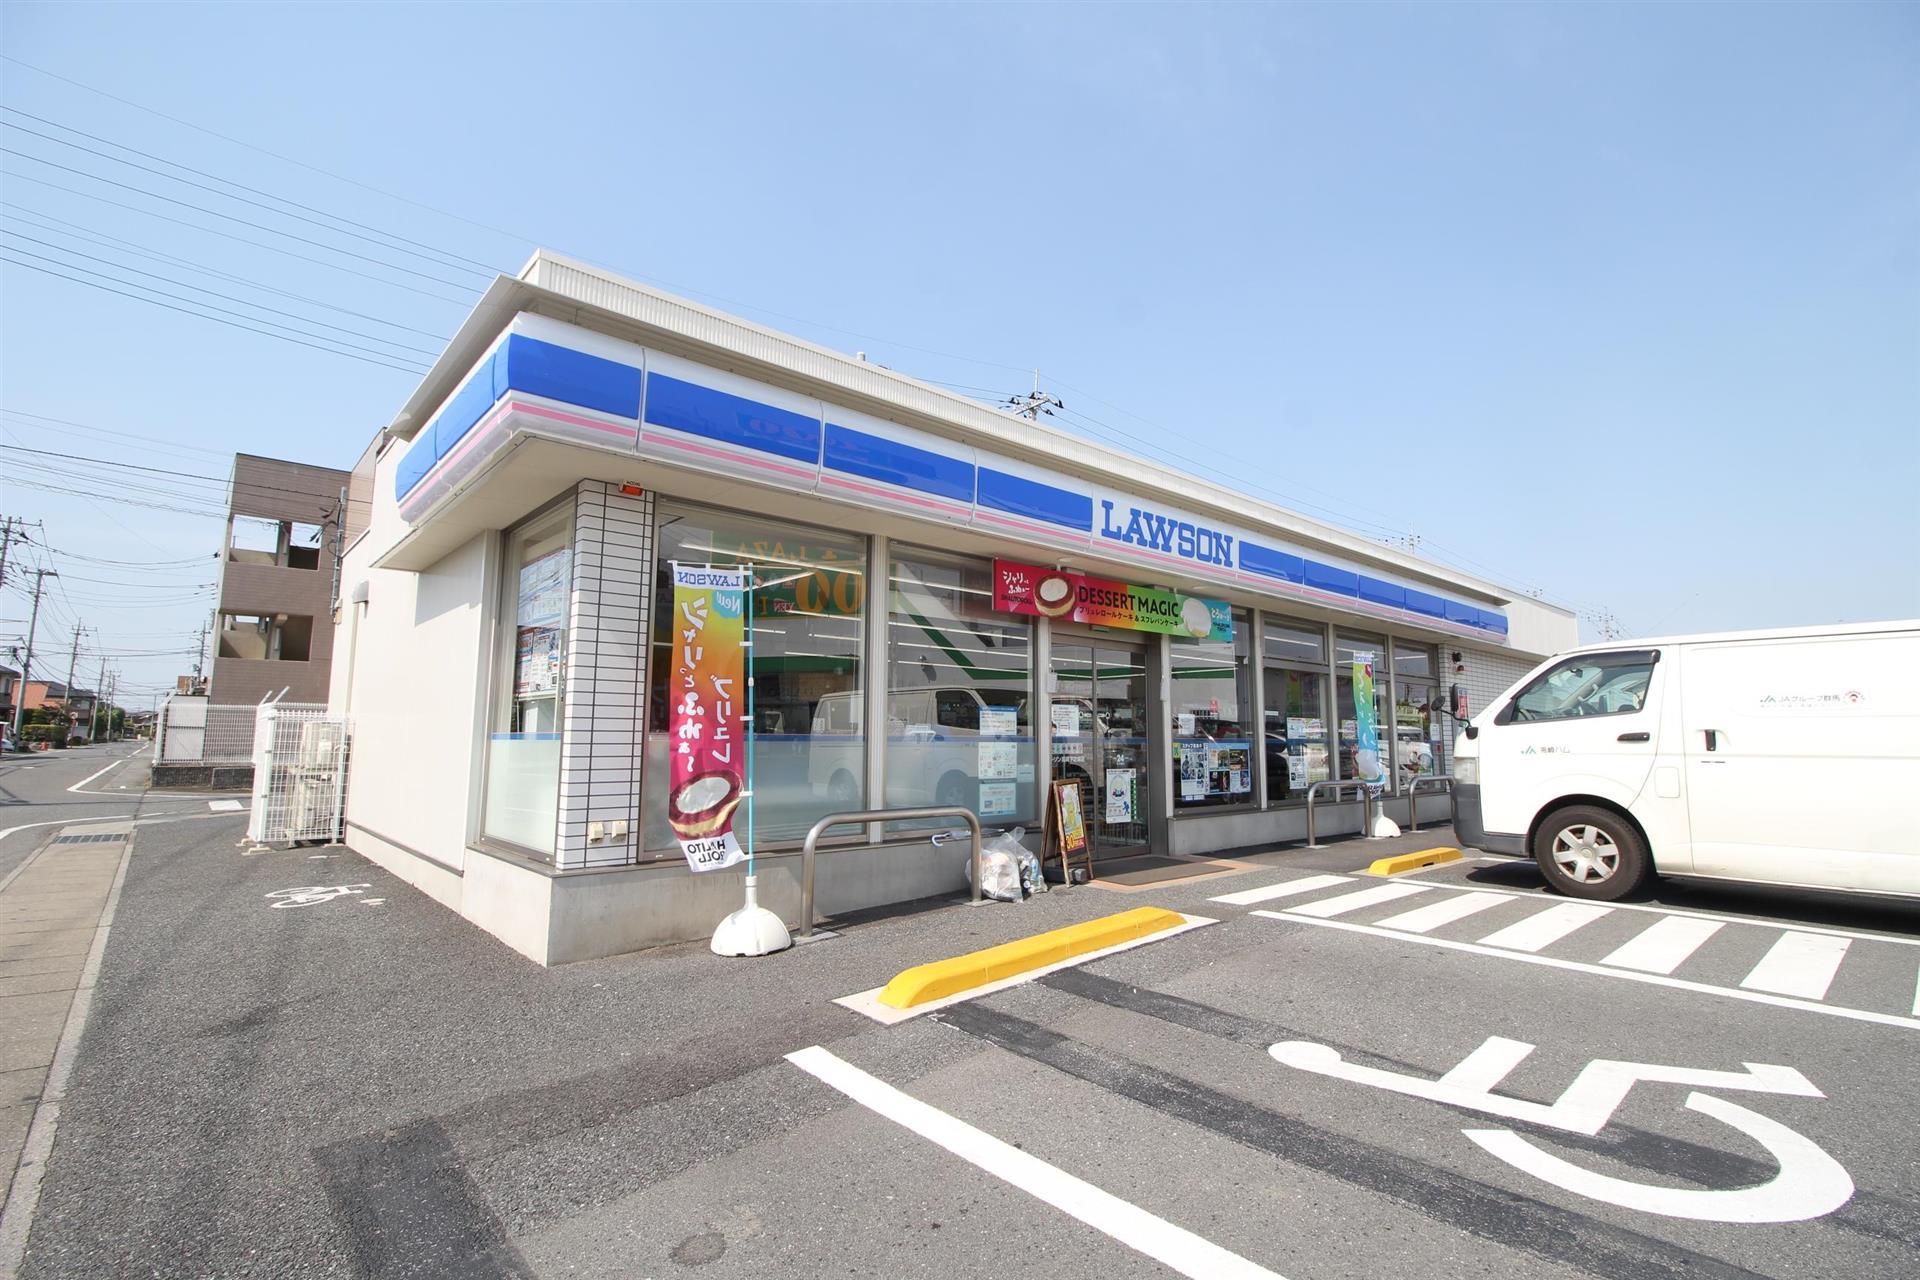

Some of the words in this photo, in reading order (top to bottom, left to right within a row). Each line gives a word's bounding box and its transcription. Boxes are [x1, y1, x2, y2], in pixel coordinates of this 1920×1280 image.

[1101, 500, 1233, 567] LAWSON
[1078, 586, 1136, 611] DESSERT
[1138, 596, 1180, 618] MAGIC
